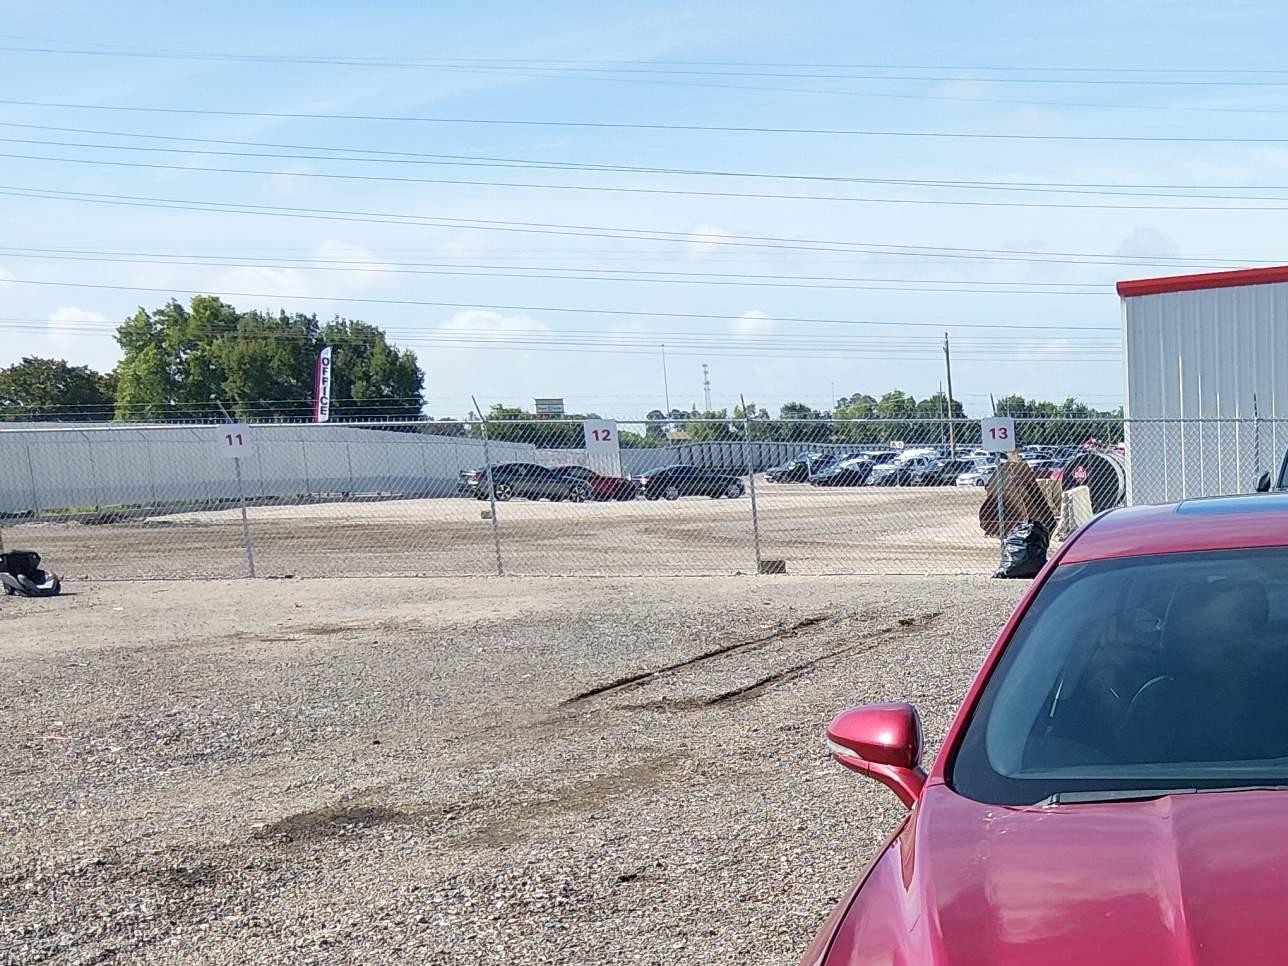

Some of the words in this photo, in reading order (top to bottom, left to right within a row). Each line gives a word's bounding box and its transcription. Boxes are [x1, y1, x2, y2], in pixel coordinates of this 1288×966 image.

[320, 357, 330, 415] OFFICE
[592, 429, 611, 441] 12
[989, 427, 1008, 440] 13
[225, 434, 243, 446] 11
